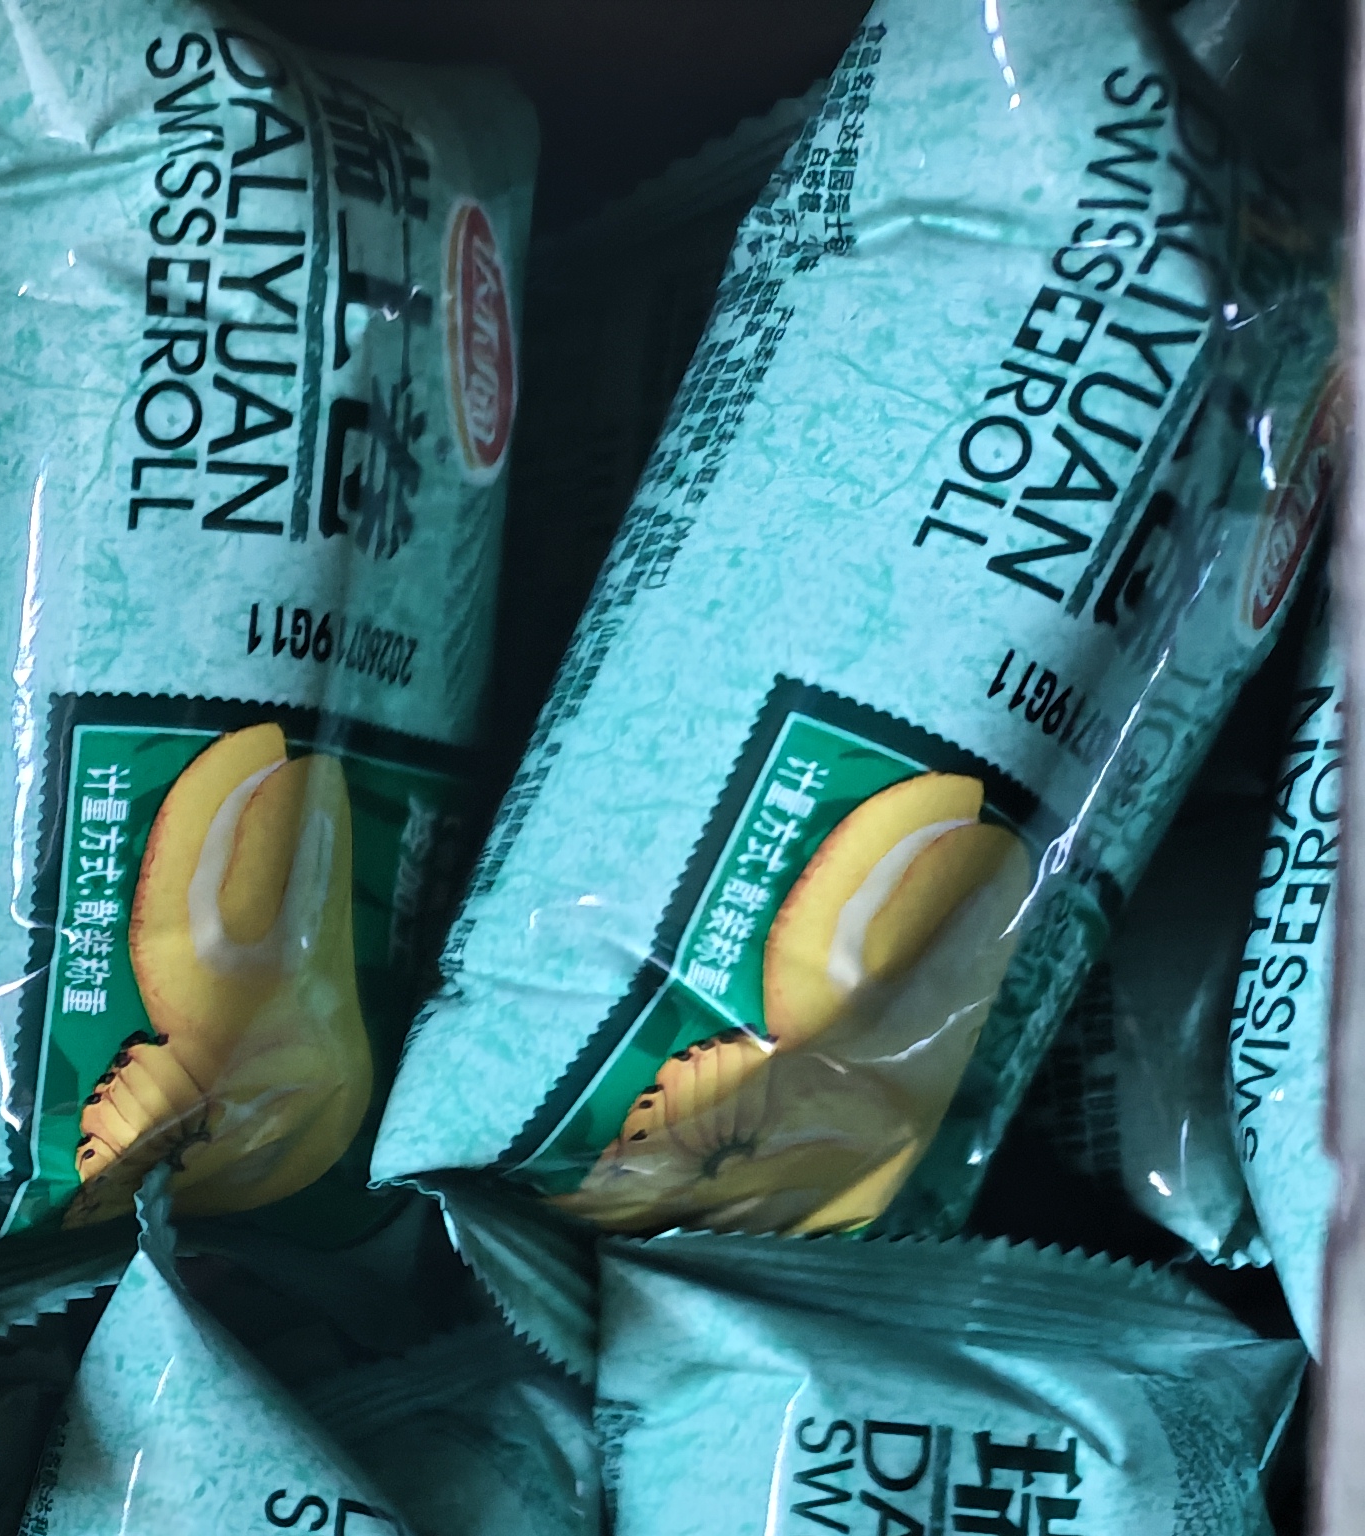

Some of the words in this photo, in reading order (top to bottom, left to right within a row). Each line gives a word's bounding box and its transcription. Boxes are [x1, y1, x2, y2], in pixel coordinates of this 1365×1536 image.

[146, 32, 224, 245] SWISS
[1052, 68, 1170, 290] SWISS
[202, 29, 306, 534] DALIYUAN
[128, 330, 208, 530] ROLL
[913, 361, 1067, 546] ROLL
[62, 766, 131, 1014] 计量方式：散装称重
